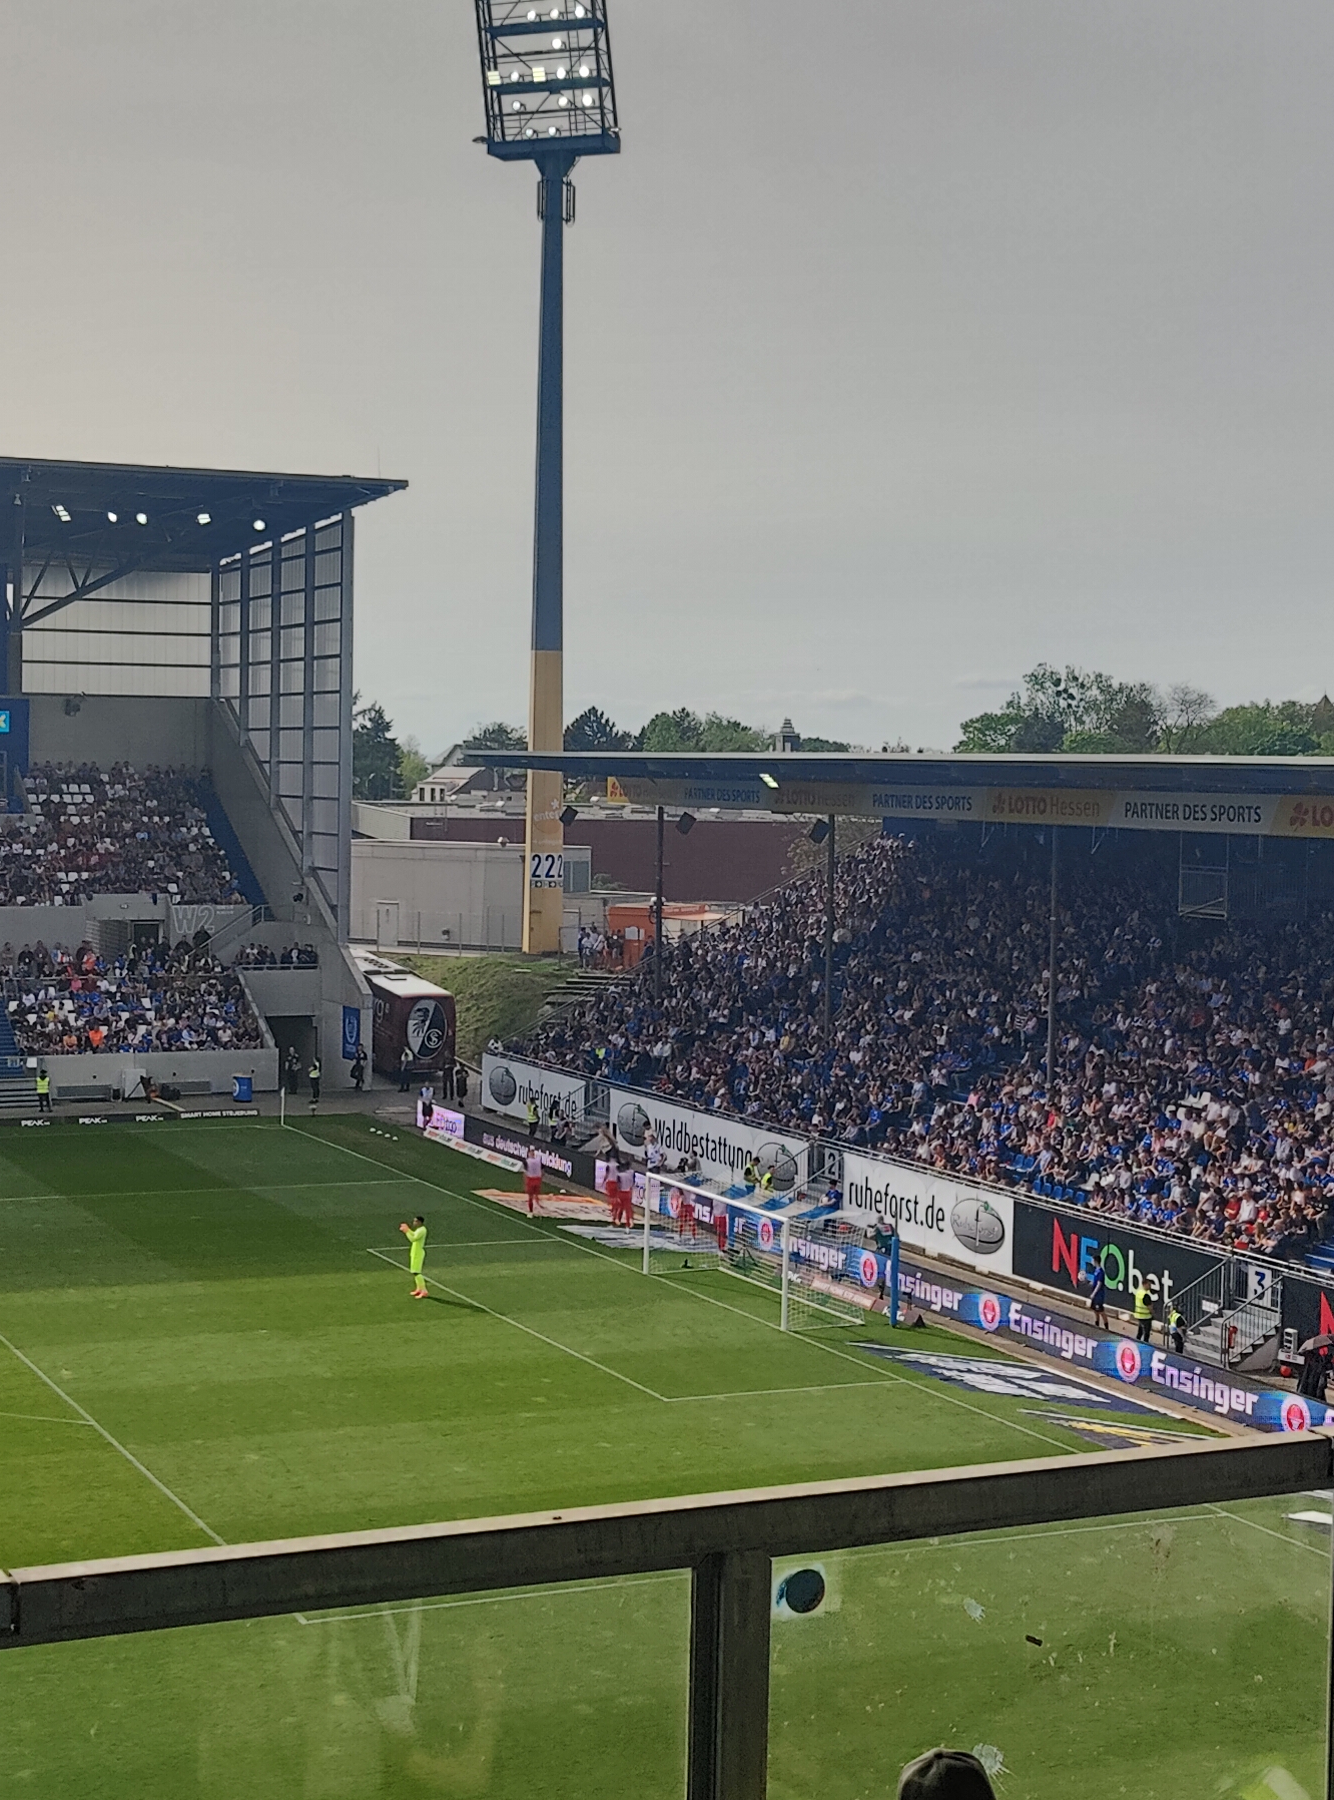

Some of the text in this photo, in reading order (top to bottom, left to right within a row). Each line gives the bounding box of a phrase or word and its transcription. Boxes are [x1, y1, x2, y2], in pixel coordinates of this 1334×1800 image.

[872, 794, 972, 811] PARTNER DES SPORTS
[1008, 798, 1100, 817] LOTTO Hessen
[1124, 802, 1262, 823] PARTNER DES SPORTS
[171, 905, 215, 933] W2
[483, 1132, 495, 1147] aus
[827, 1153, 836, 1177] 2
[849, 1176, 945, 1232] ruheforst.de
[1253, 1271, 1266, 1300] 3
[1008, 1302, 1098, 1359] Ensinger
[1151, 1350, 1259, 1414] Ensinger
